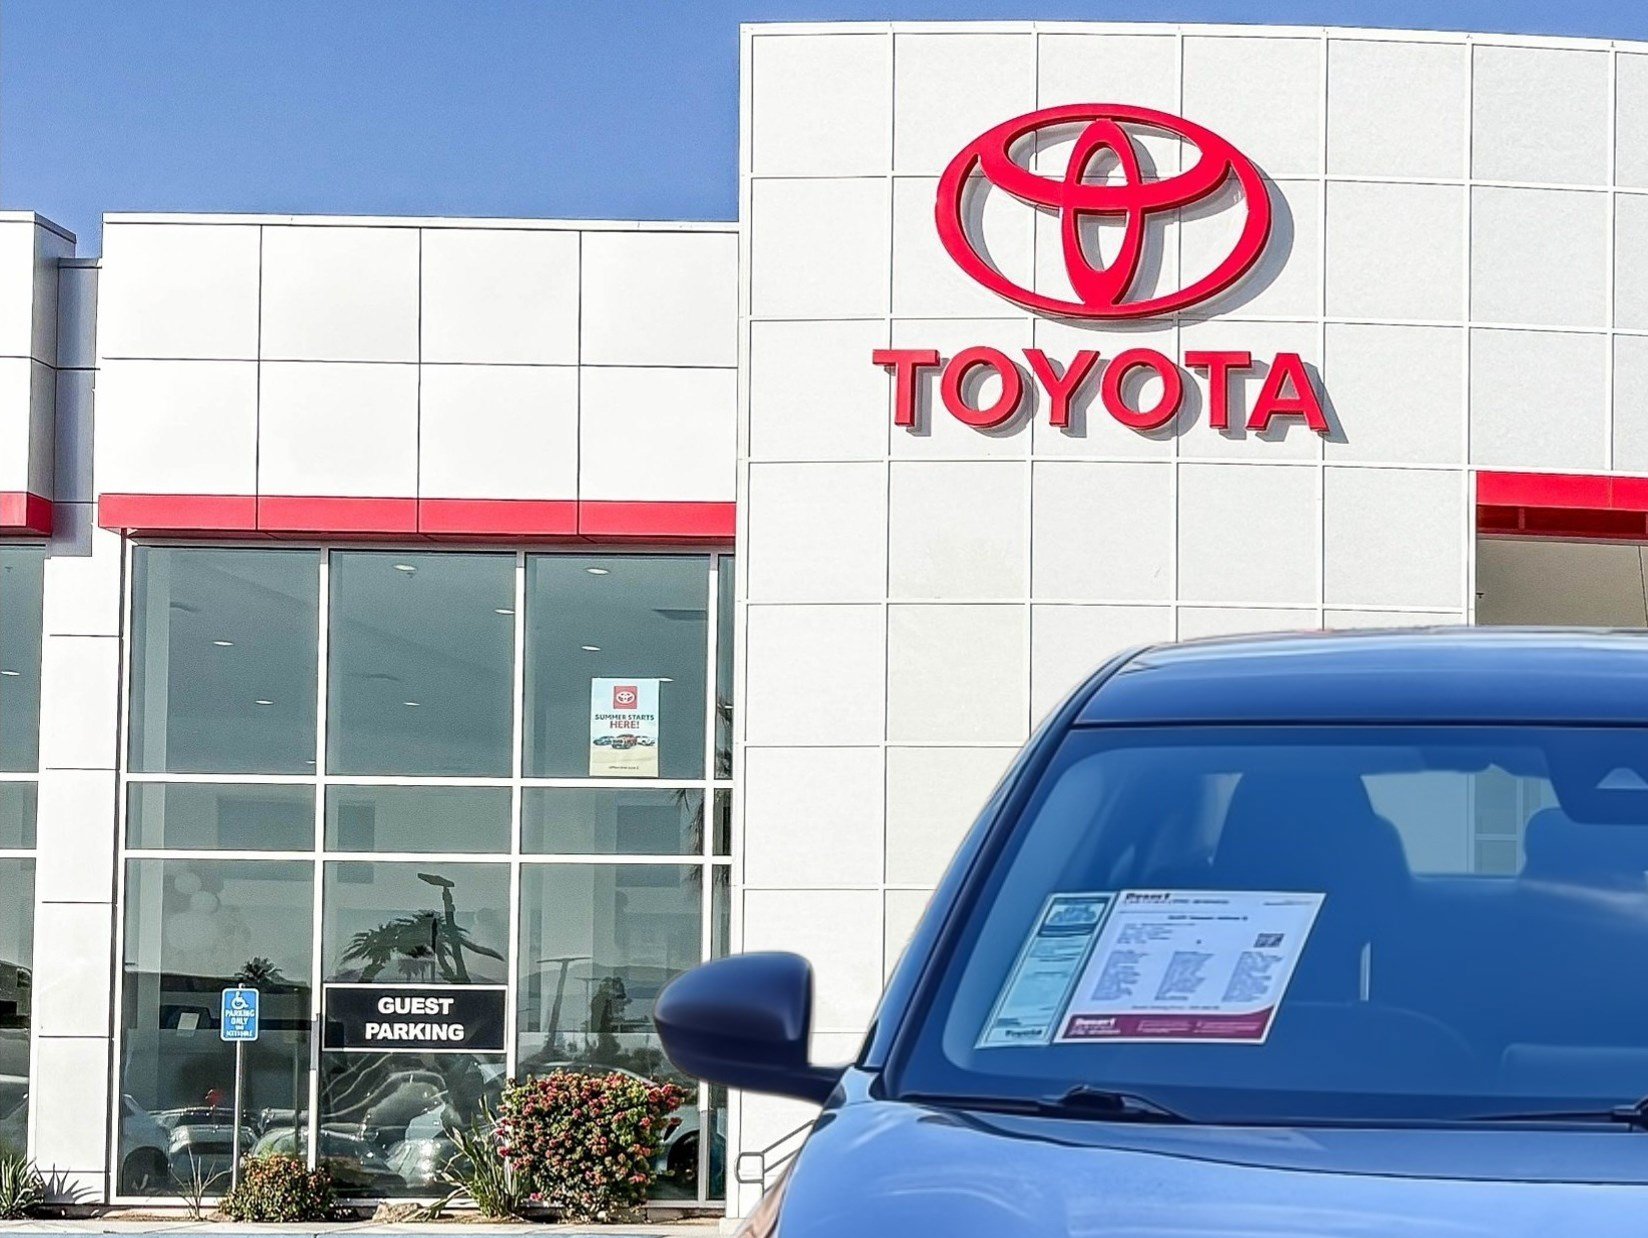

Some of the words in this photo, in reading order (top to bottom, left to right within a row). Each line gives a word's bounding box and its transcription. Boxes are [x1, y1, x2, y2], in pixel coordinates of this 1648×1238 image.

[872, 346, 1330, 432] TOYOTA
[594, 713, 626, 721] SUMMER
[609, 720, 640, 729] HERE!
[377, 997, 455, 1015] GUEST
[225, 1009, 255, 1017] PARKING
[230, 1017, 249, 1025] ONLY
[365, 1022, 465, 1041] PARKING
